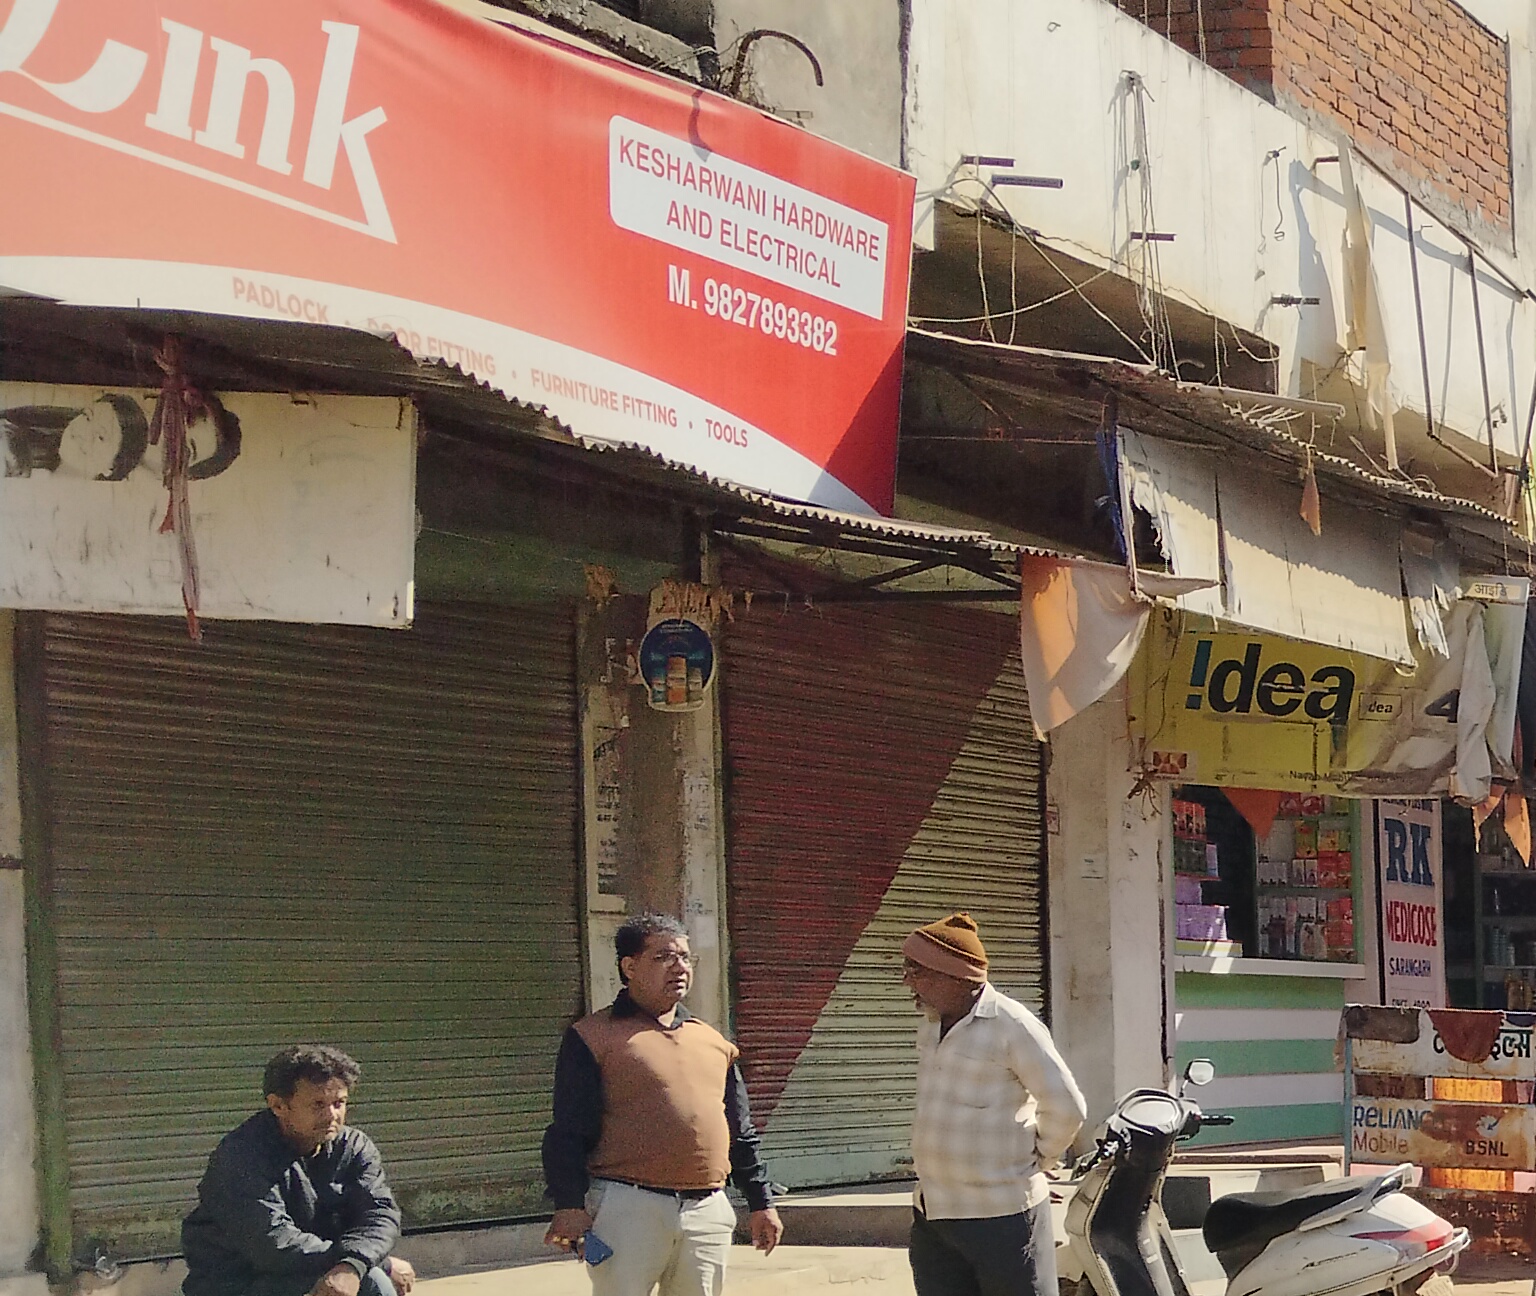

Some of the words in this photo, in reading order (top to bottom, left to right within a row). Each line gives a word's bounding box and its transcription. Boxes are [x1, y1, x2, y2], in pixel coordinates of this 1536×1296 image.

[619, 135, 766, 217] KESHARWANI
[773, 195, 879, 261] HARDWARE
[667, 200, 713, 239] AND
[720, 220, 841, 288] ELECTRICAL
[232, 277, 329, 324] PADLOCK
[668, 264, 698, 310] M.
[703, 278, 838, 356] 9827893382
[427, 336, 496, 375] FITTING
[530, 368, 618, 412] FURNITURE
[622, 394, 677, 427] FITTING
[705, 418, 749, 448] TOOLS
[1384, 818, 1435, 887] RK
[1386, 900, 1437, 947] MEDICOSE
[1389, 957, 1432, 977] SARANGARH
[1354, 1131, 1409, 1155] Mobile
[1466, 1140, 1509, 1157] BSNL
